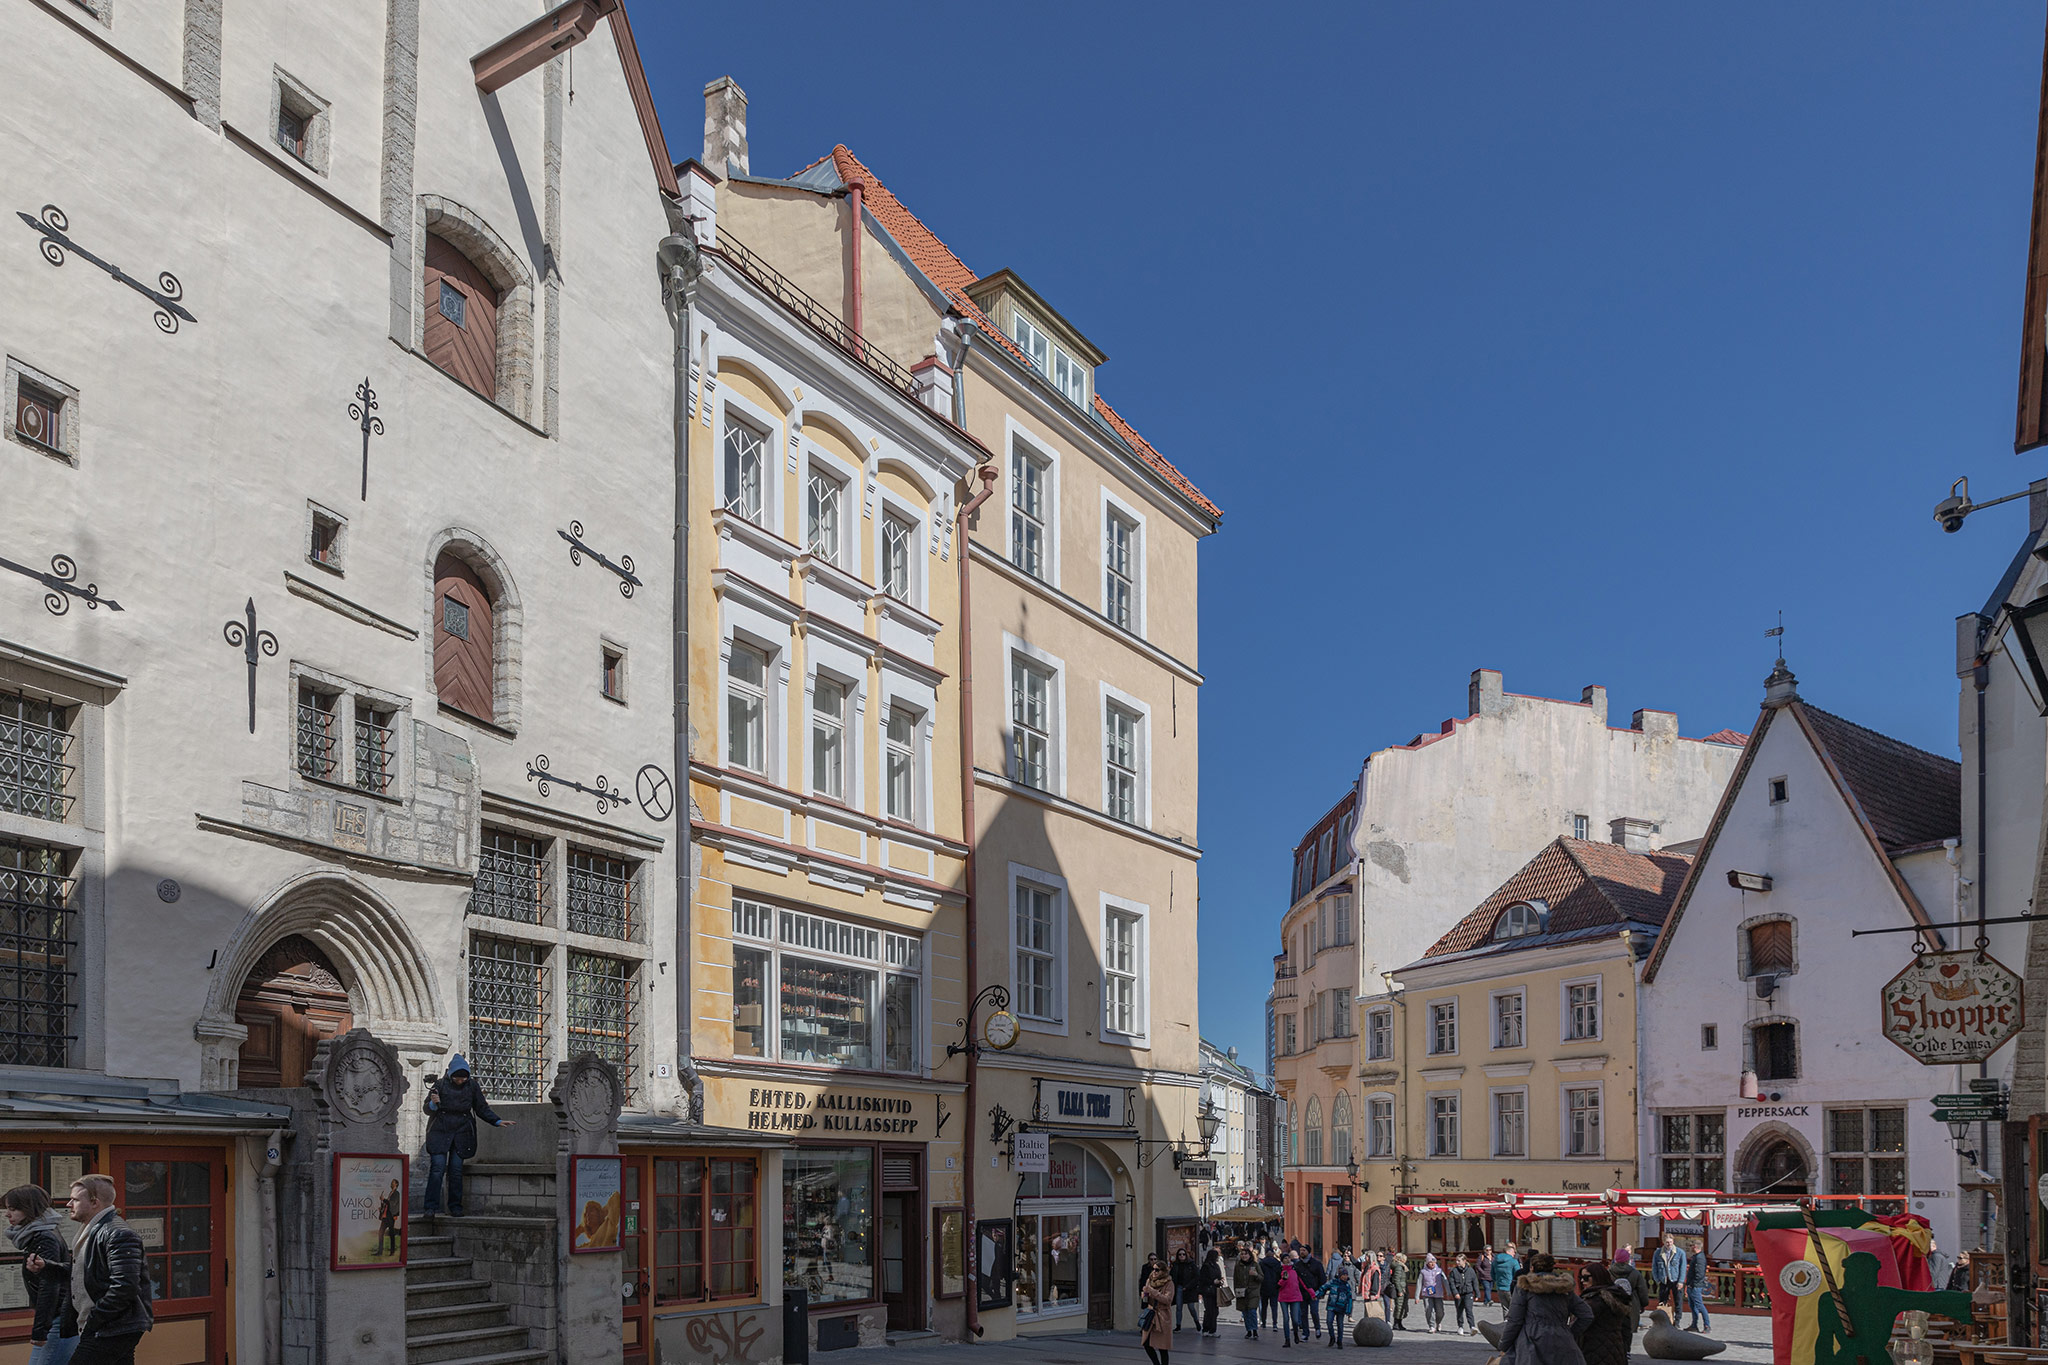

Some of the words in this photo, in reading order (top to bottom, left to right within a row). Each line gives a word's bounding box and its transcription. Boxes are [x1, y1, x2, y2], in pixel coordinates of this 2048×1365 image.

[1891, 993, 2013, 1036] Shoppe
[1912, 1037, 1947, 1053] Olde
[660, 1066, 667, 1075] 3
[816, 1093, 912, 1114] KALLISKIVID
[1057, 1090, 1085, 1116] VANA
[1087, 1093, 1111, 1118] TURG
[1738, 1106, 1809, 1118] PEPPERSACK
[824, 1115, 918, 1133] KULLASSEPP
[1019, 1139, 1045, 1149] Baltic
[1016, 1150, 1047, 1160] Amber
[1050, 1160, 1077, 1175] Baltic
[1047, 1174, 1078, 1189] Amber
[341, 1197, 373, 1208] VAIKO
[351, 1209, 378, 1220] EPLIK
[1092, 1206, 1111, 1216] BAAR
